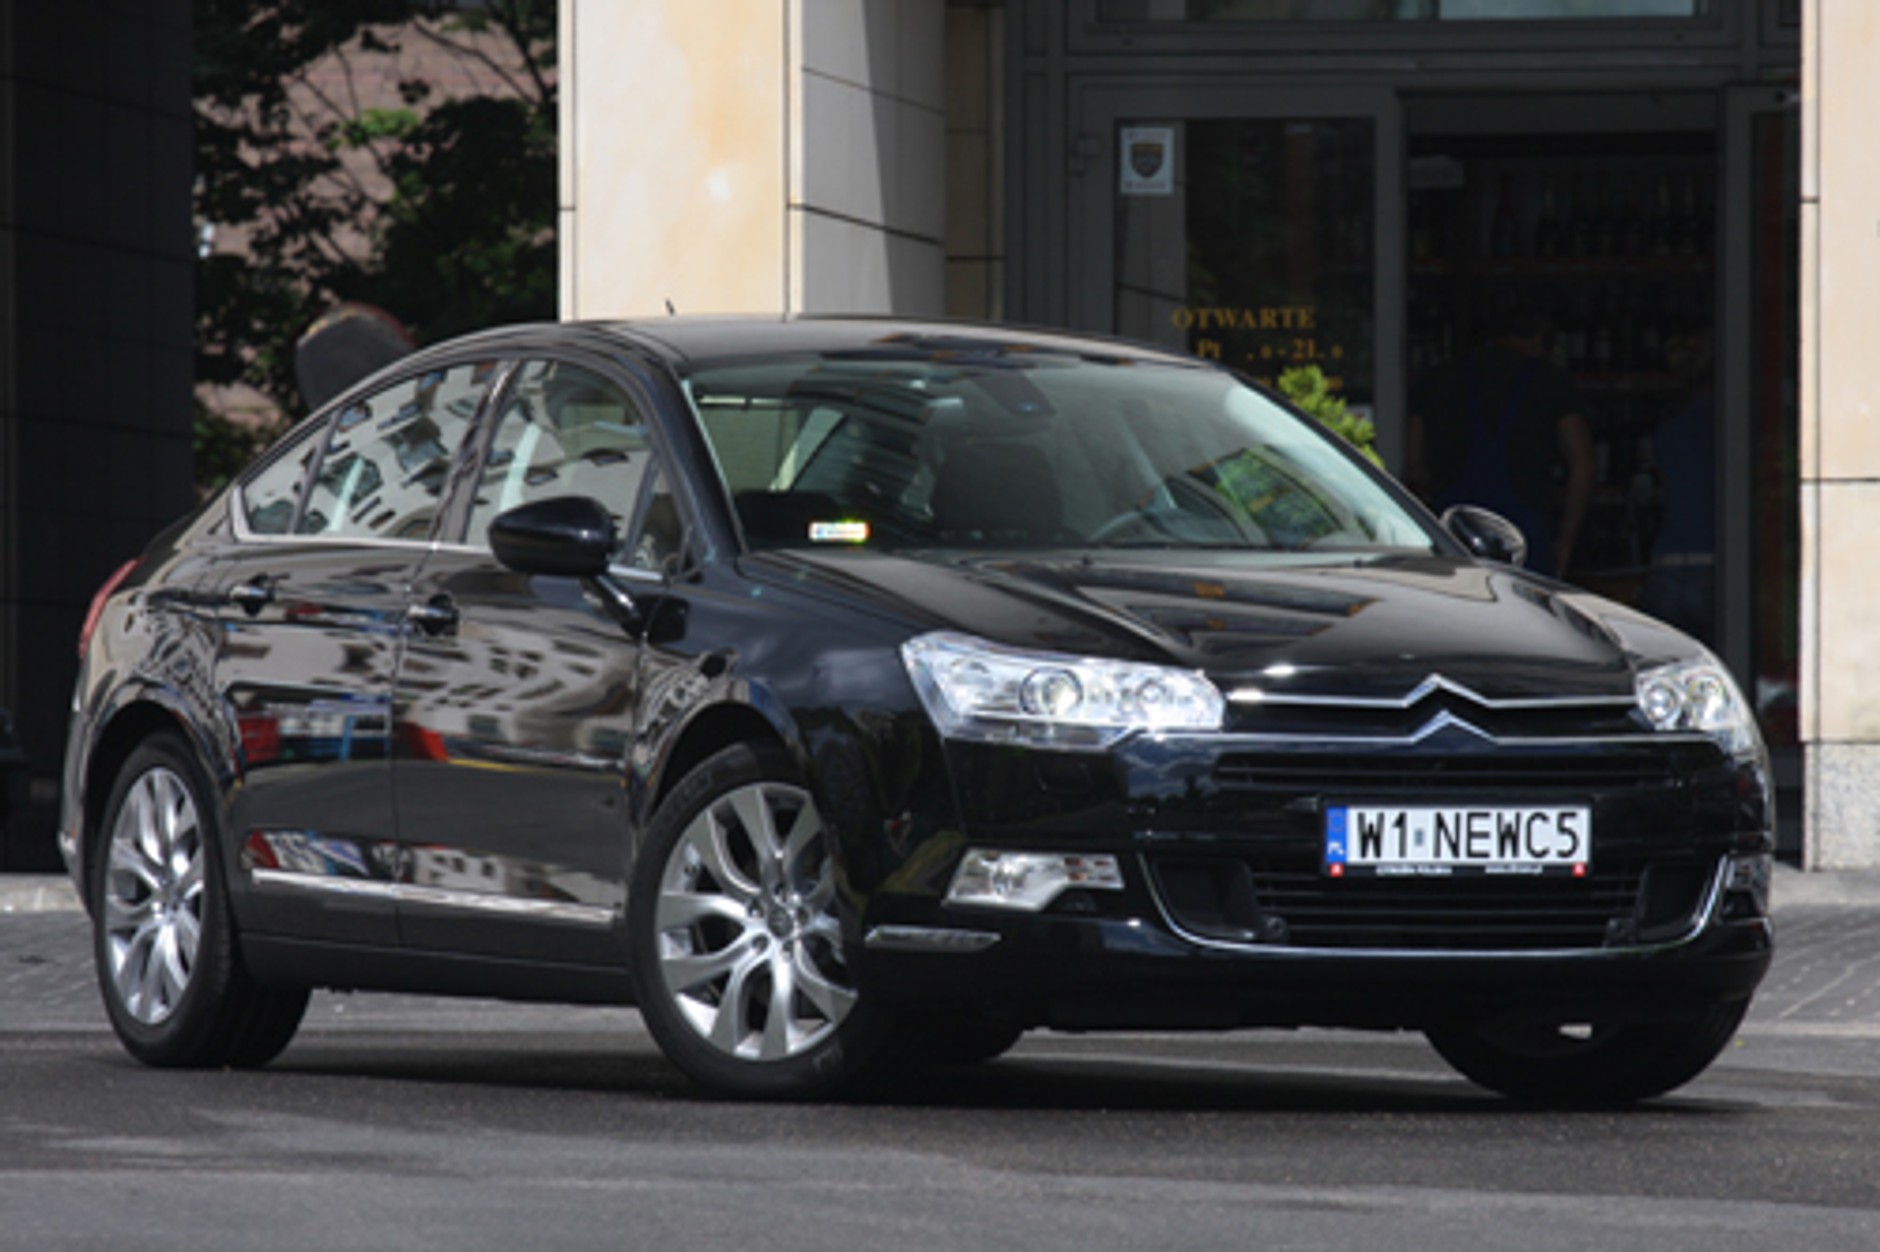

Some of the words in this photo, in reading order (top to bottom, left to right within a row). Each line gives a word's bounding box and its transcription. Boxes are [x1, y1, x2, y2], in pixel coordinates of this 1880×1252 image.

[1172, 307, 1316, 329] OTWARTE
[1357, 811, 1407, 858] W1
[1433, 811, 1578, 858] NEWC5
